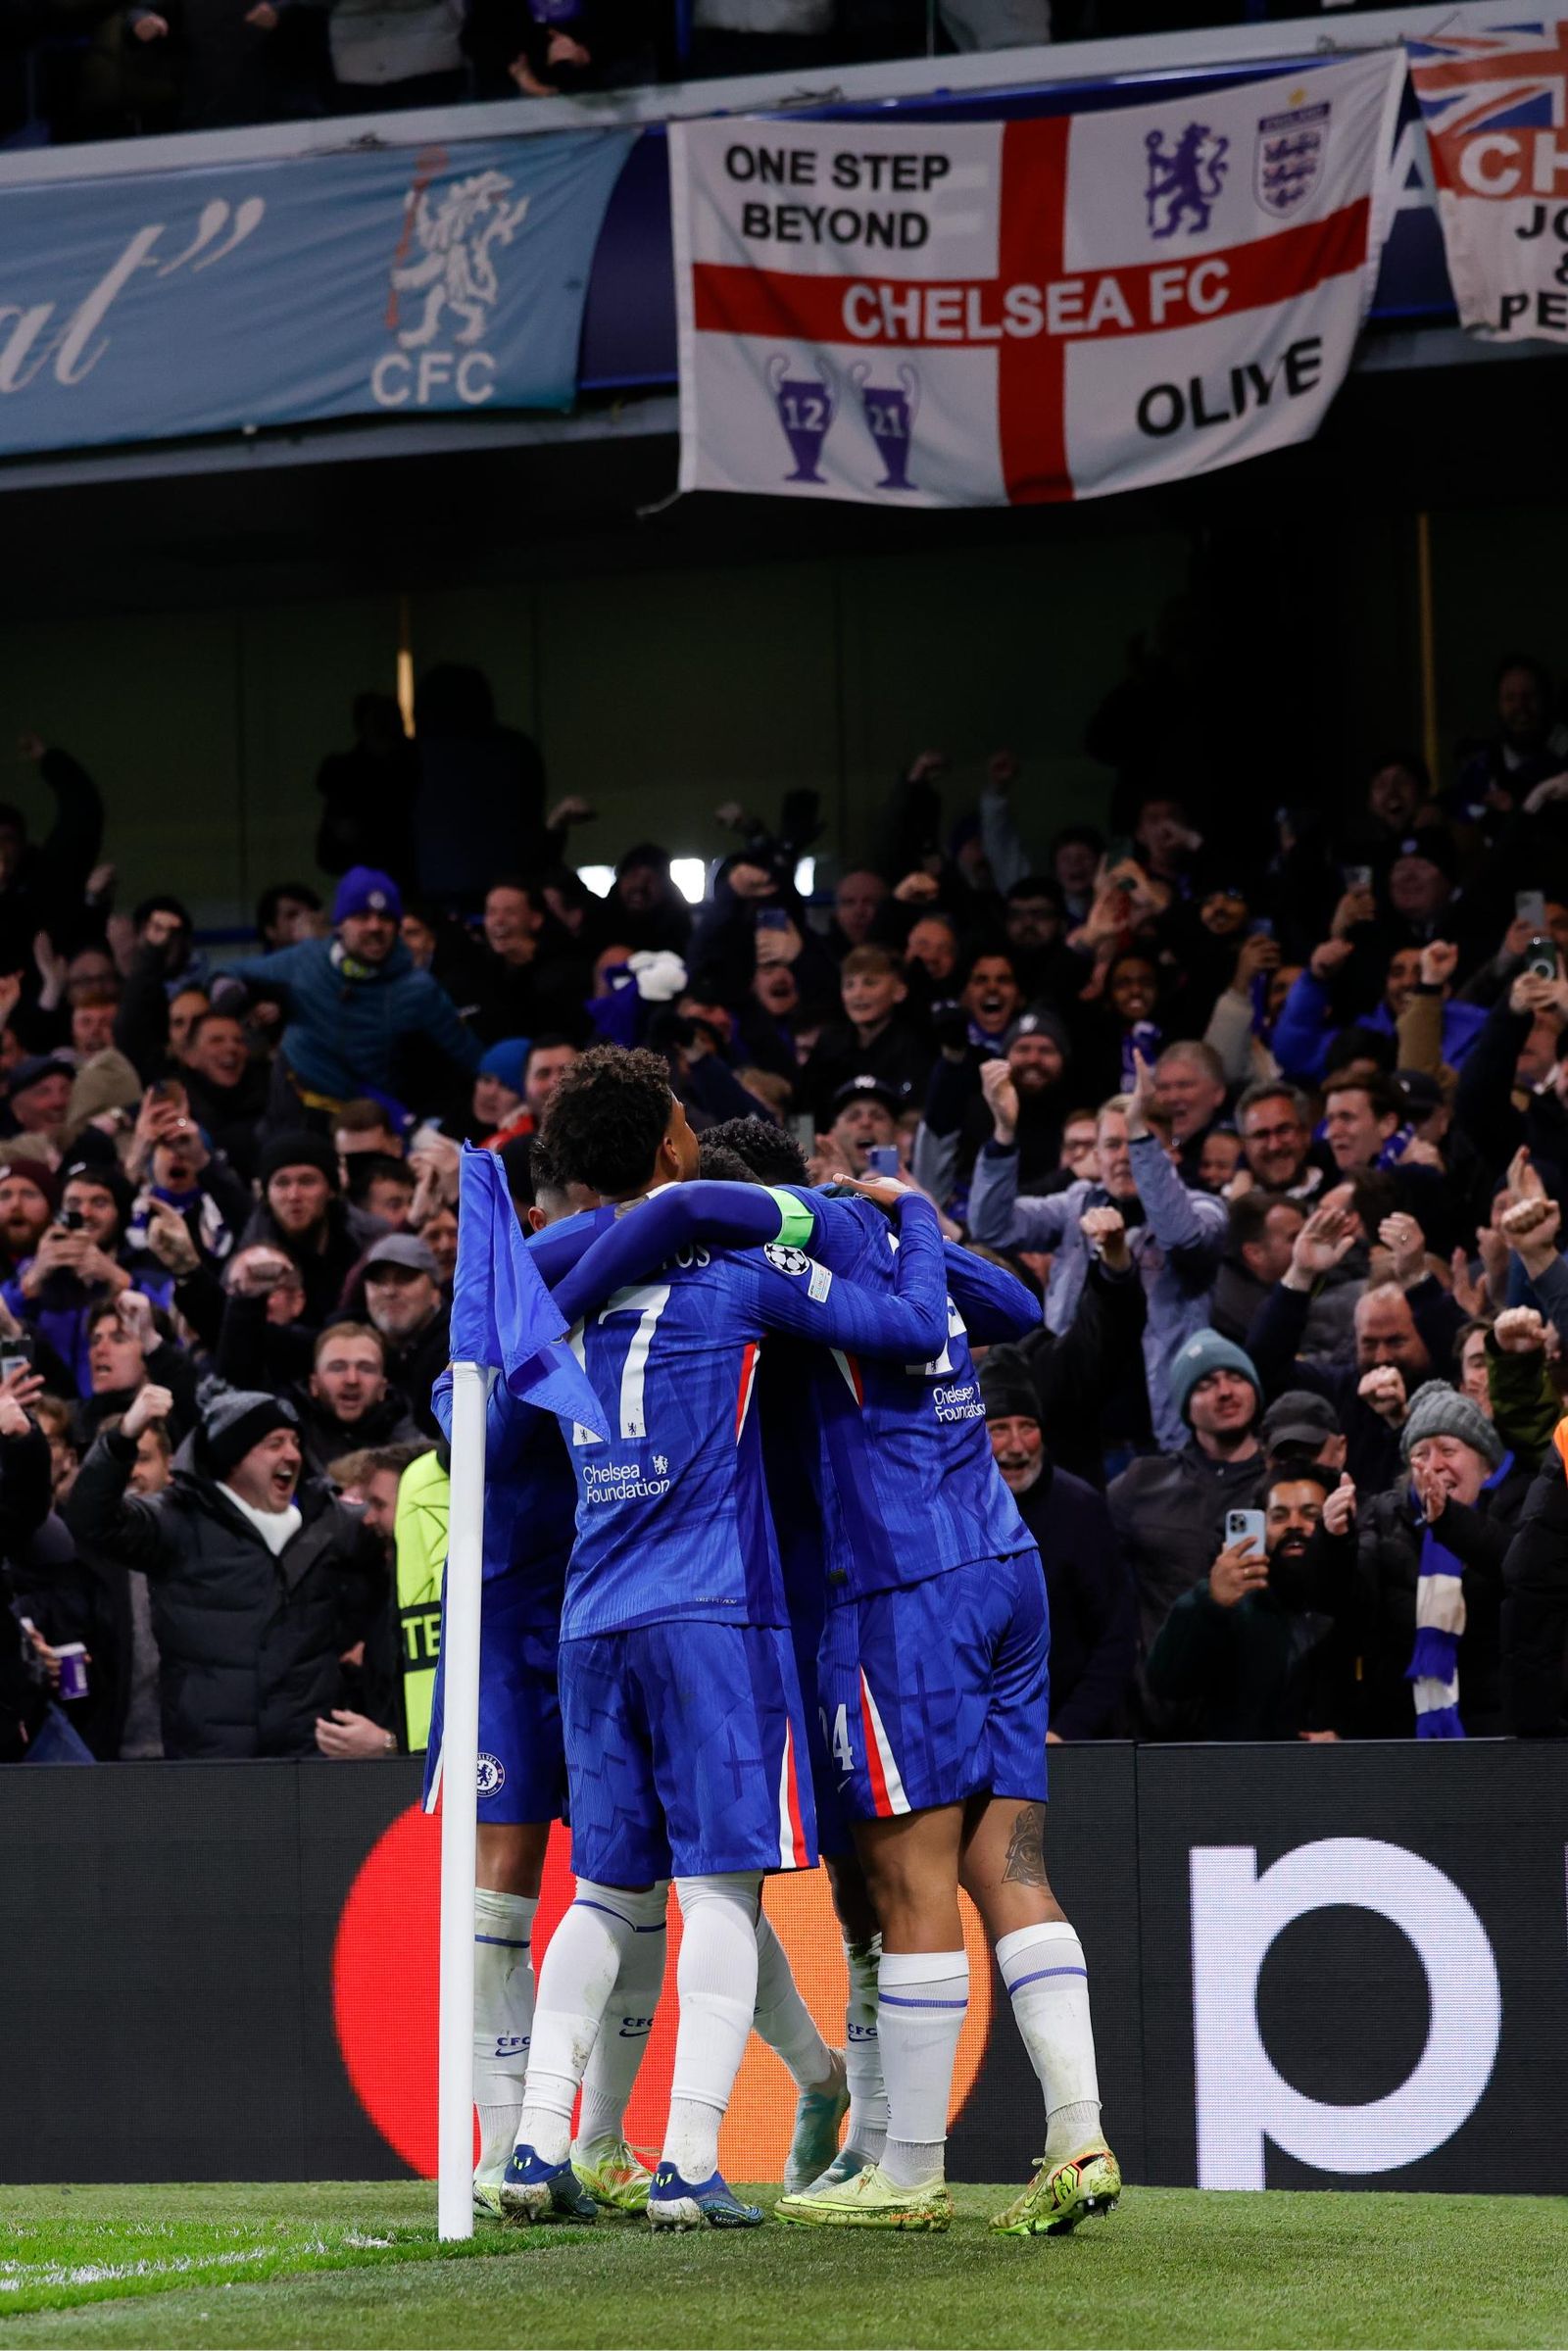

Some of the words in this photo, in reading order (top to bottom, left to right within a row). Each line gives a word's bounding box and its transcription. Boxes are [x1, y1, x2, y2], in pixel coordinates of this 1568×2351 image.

[725, 144, 816, 185] ONE
[832, 152, 951, 191] STEP
[742, 202, 929, 250] BEYOND
[841, 274, 1135, 340] CHELSEA
[1149, 259, 1231, 324] FC
[1498, 291, 1568, 331] PE
[369, 351, 497, 407] CFC
[784, 396, 825, 432] 12
[868, 404, 906, 439] 21
[582, 1461, 641, 1485] Chelsea
[586, 1478, 670, 1504] Foundation
[622, 2017, 655, 2028] CFC
[847, 2022, 878, 2037] CFC
[1189, 1837, 1568, 2191] p
[496, 2035, 531, 2047] CFC
